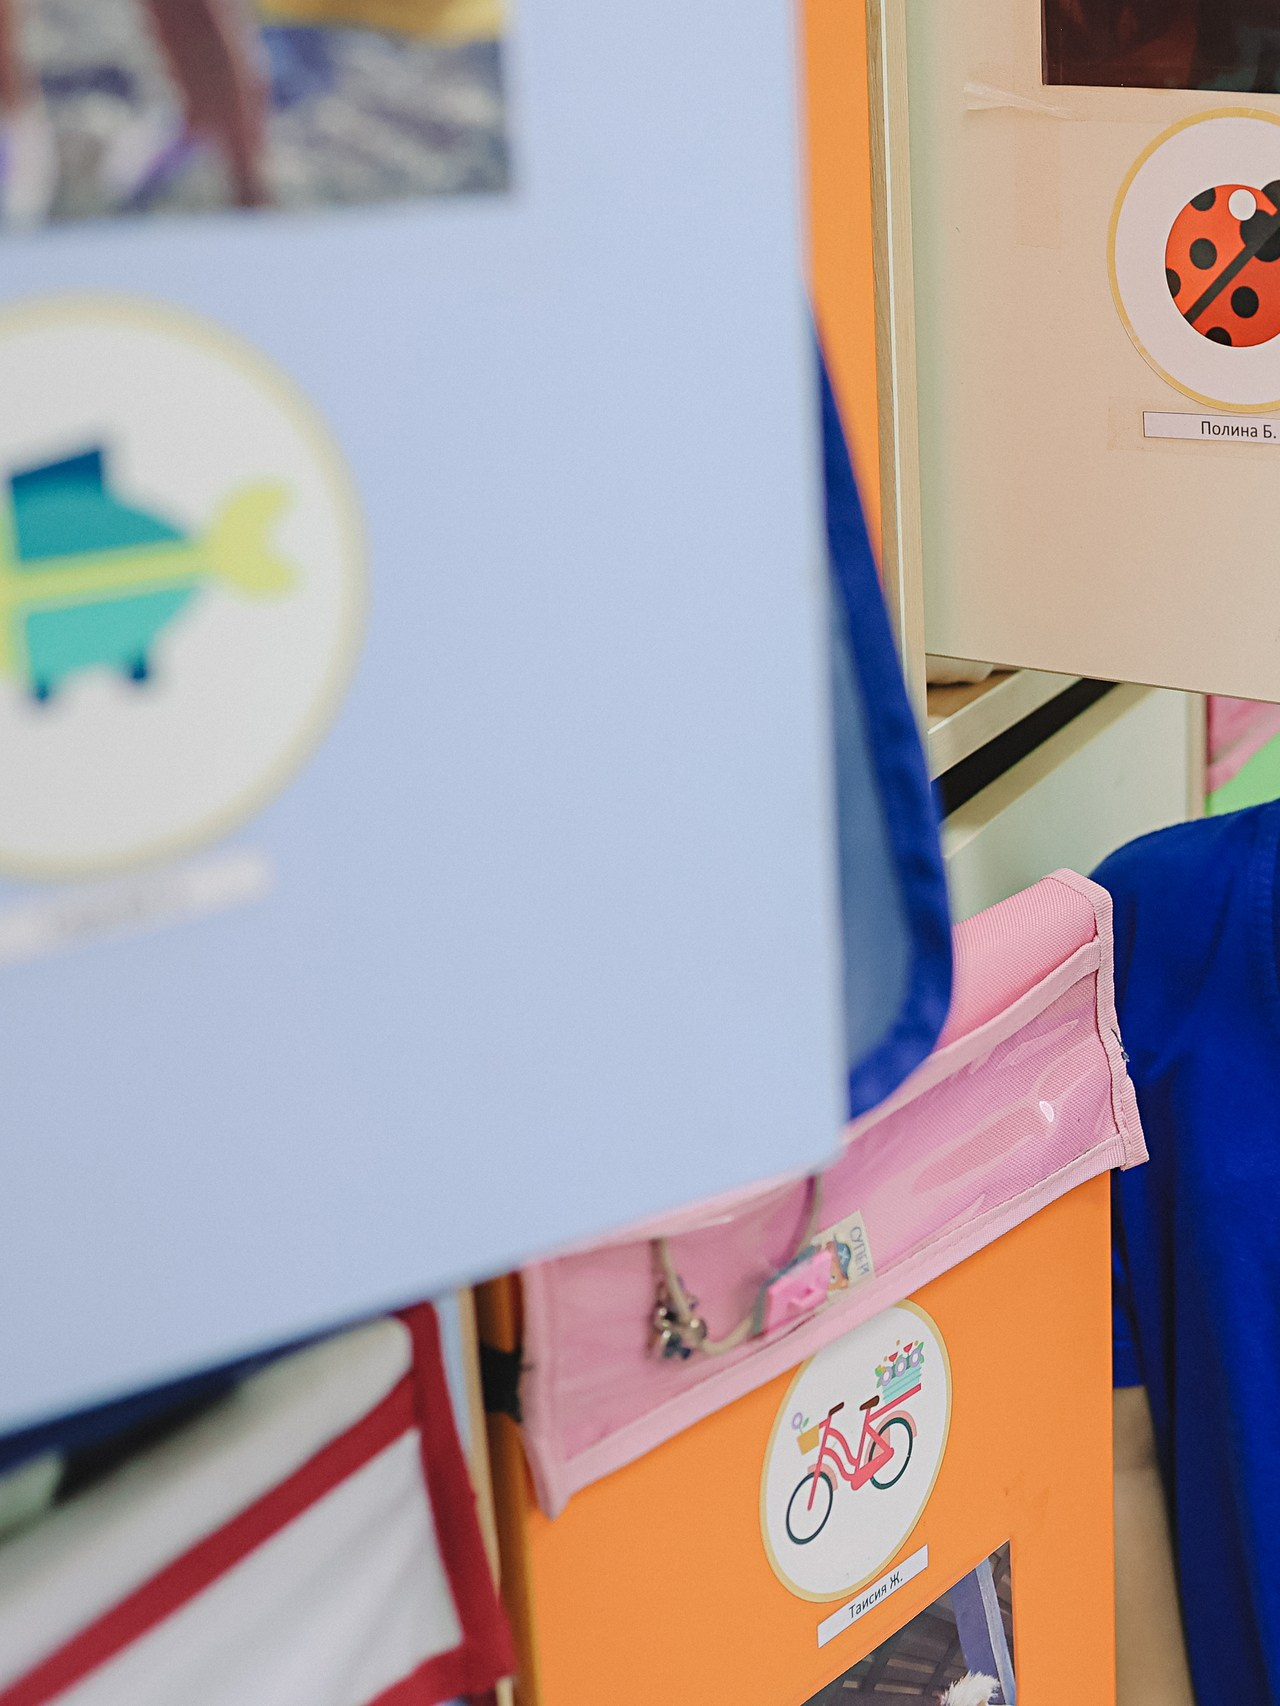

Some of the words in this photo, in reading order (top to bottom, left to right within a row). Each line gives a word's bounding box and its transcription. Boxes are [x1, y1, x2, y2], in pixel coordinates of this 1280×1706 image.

[1201, 420, 1258, 438] Полина
[1263, 424, 1277, 439] Б.
[848, 1584, 887, 1619] Таисия
[889, 1571, 904, 1590] Ж.
